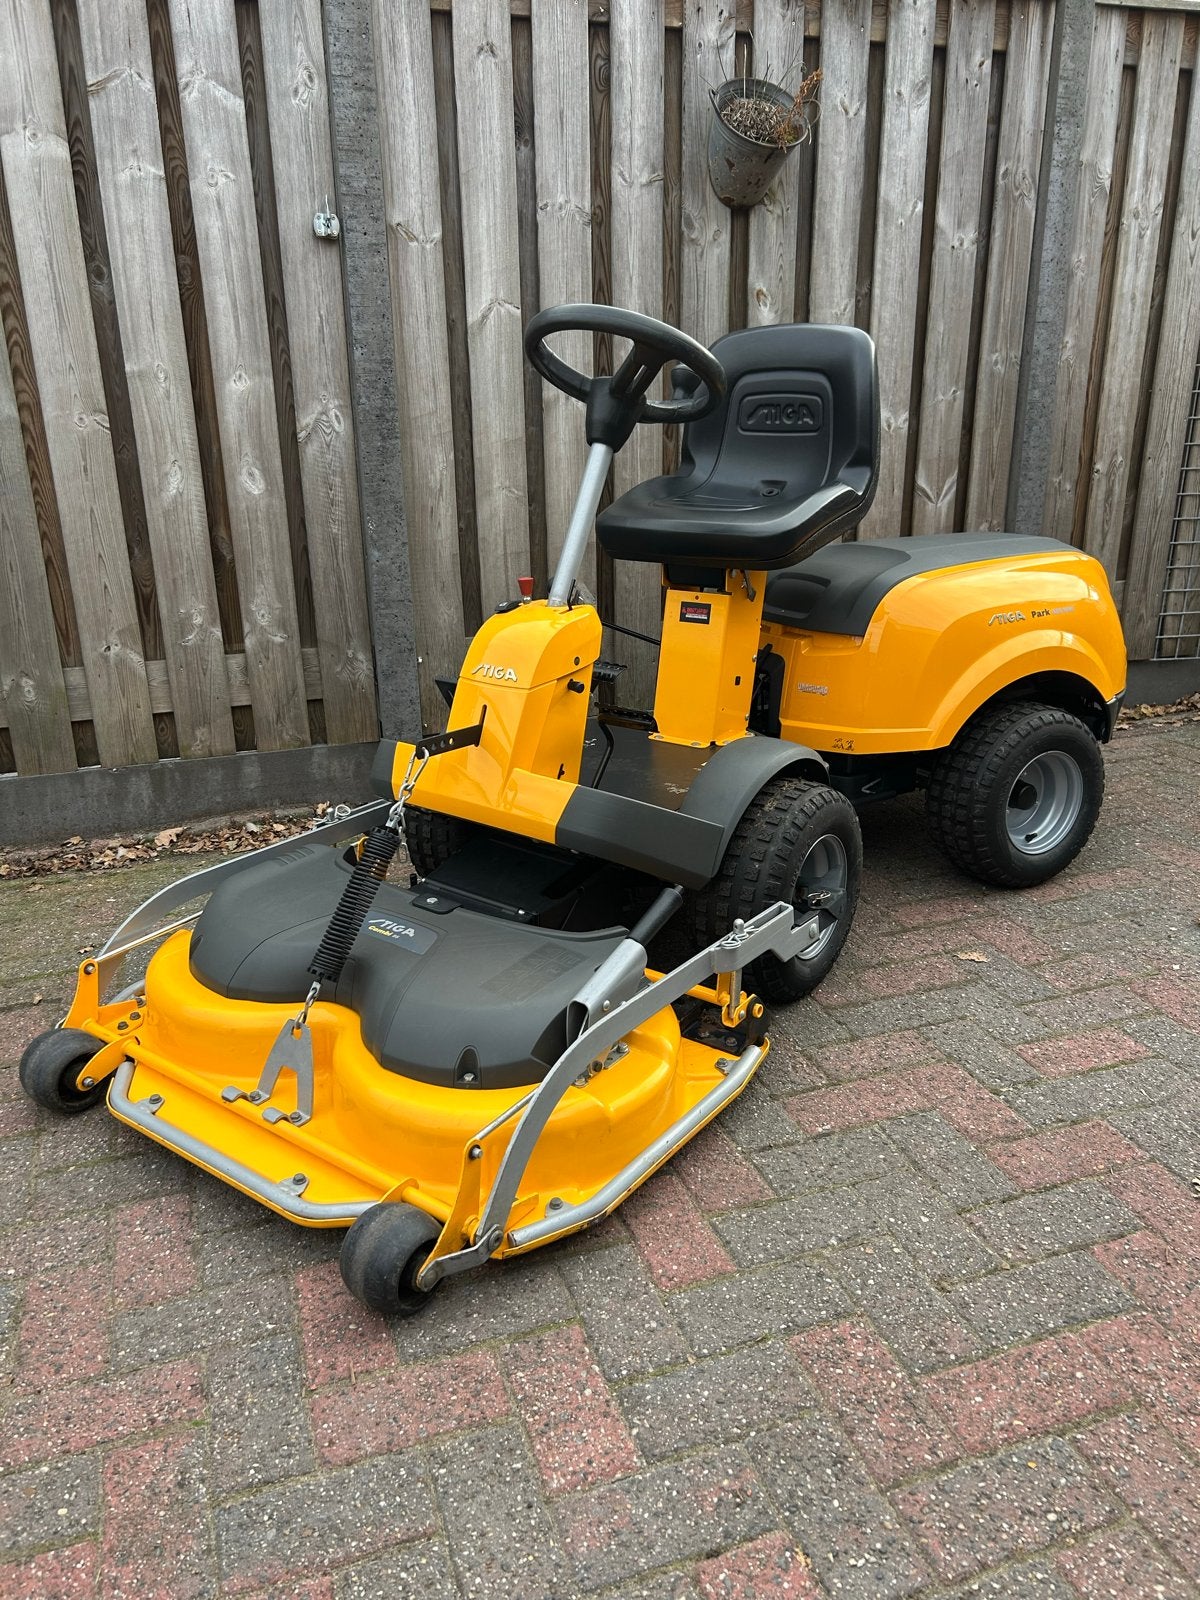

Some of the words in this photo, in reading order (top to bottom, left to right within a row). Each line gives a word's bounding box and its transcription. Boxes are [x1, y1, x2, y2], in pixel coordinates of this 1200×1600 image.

[746, 403, 814, 425] STIGA
[987, 610, 1026, 626] STIGA
[1031, 608, 1051, 618] Park
[472, 664, 518, 682] STIGA
[368, 919, 415, 937] STIGA
